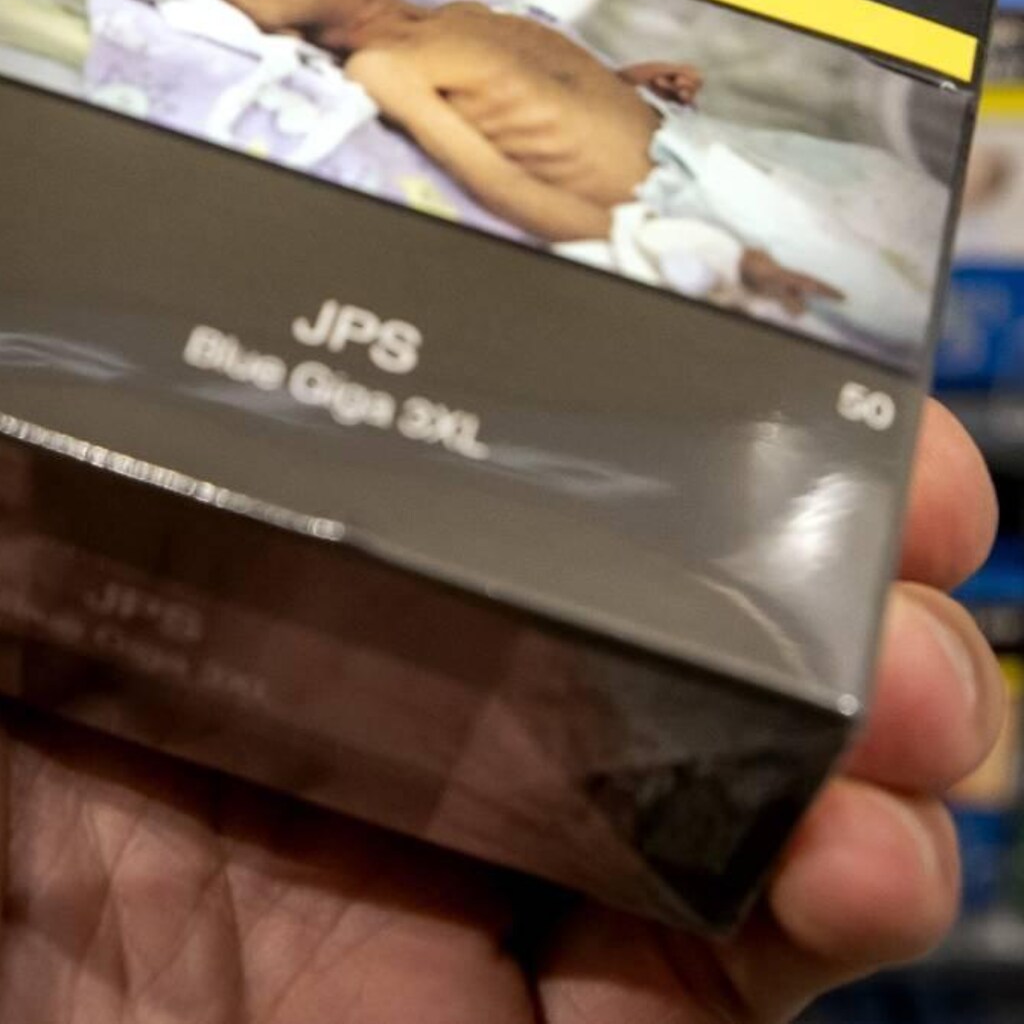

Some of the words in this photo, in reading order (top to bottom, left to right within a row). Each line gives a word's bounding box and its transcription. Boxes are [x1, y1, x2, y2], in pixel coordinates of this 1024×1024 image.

[291, 299, 423, 375] JPS
[183, 325, 287, 392] Blue
[288, 360, 396, 429] Giga
[397, 395, 490, 461] 3XL
[836, 380, 896, 432] 50
